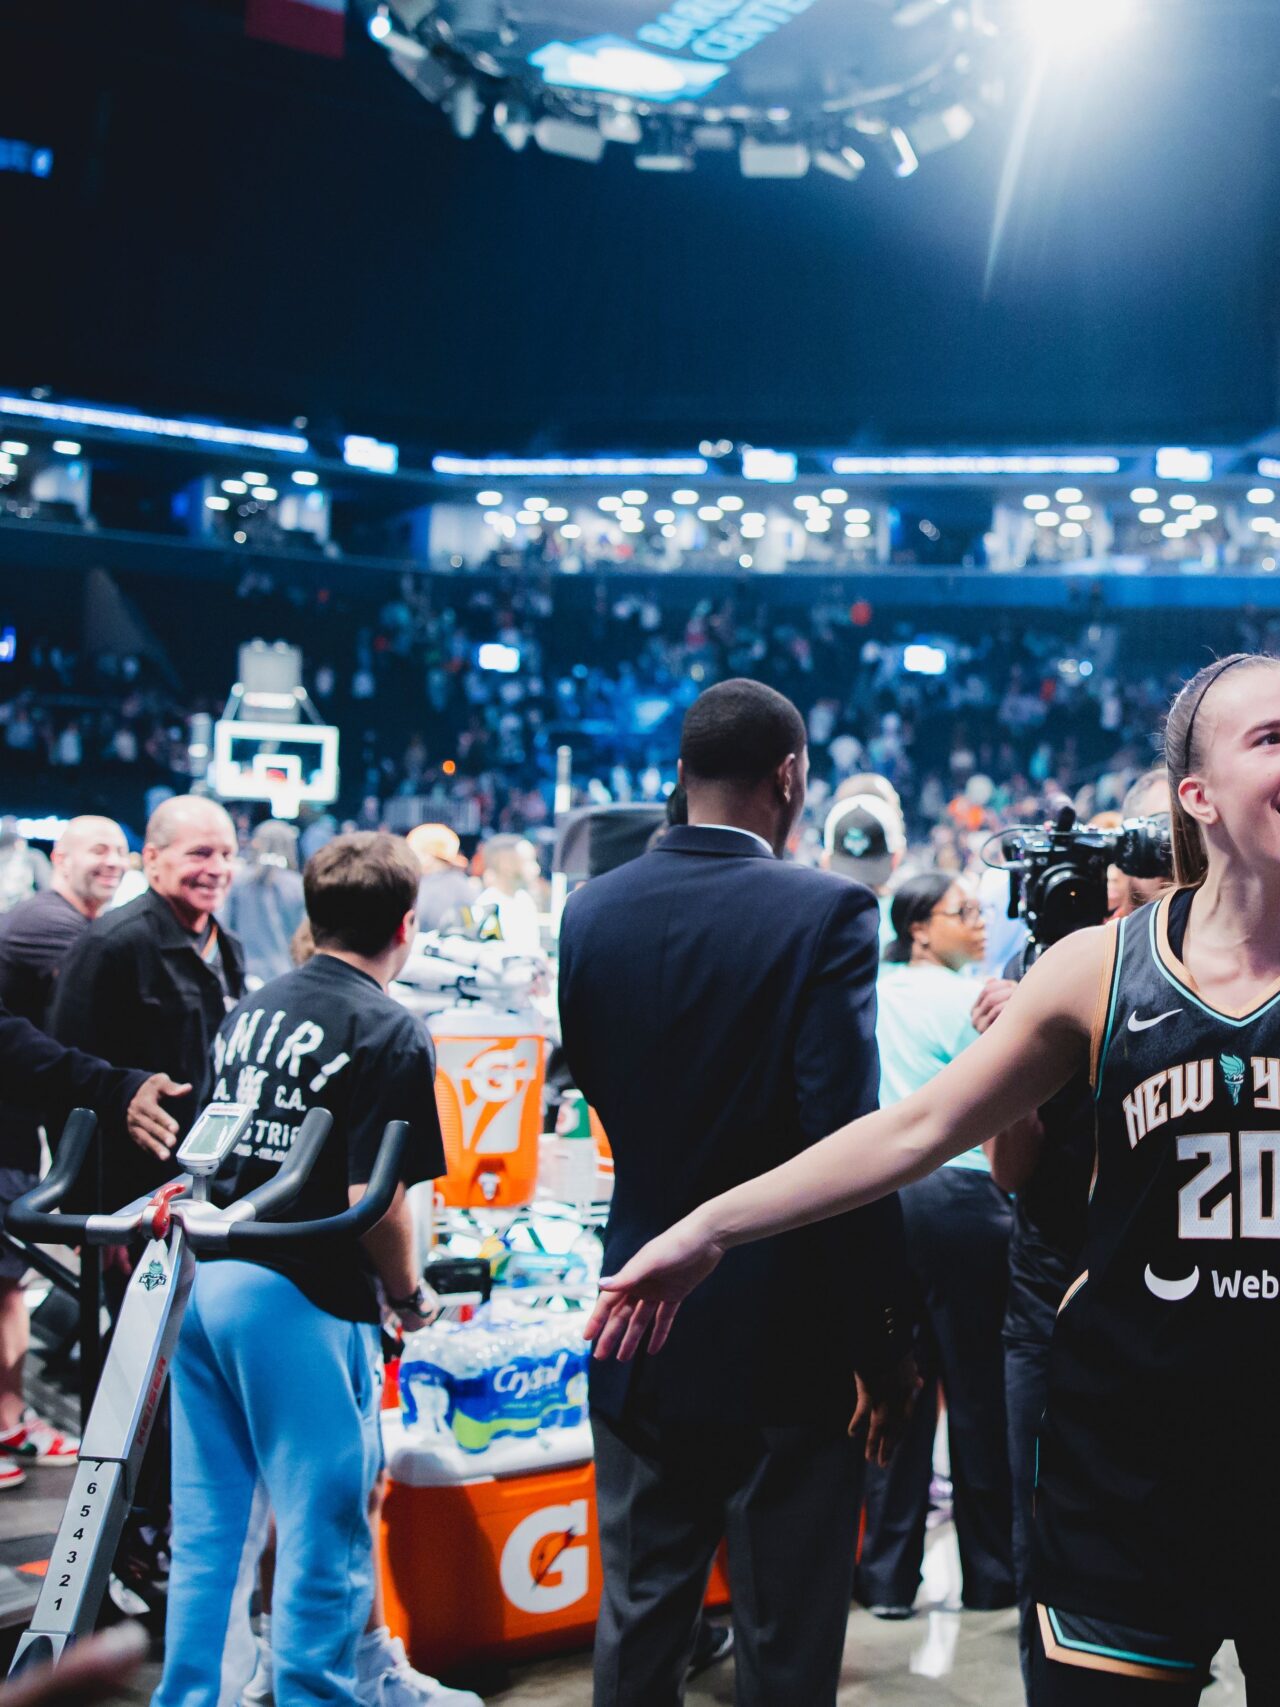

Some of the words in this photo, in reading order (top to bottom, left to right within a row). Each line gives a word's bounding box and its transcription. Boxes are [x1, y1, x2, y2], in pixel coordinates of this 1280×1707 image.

[471, 1049, 516, 1102] G
[1122, 1058, 1214, 1150] NEW
[87, 1482, 98, 1495] 6
[80, 1505, 91, 1517] 5
[73, 1527, 84, 1540] 4
[66, 1551, 77, 1564] 3
[500, 1498, 588, 1614] G
[59, 1574, 71, 1587] 2
[54, 1598, 63, 1611] 1
